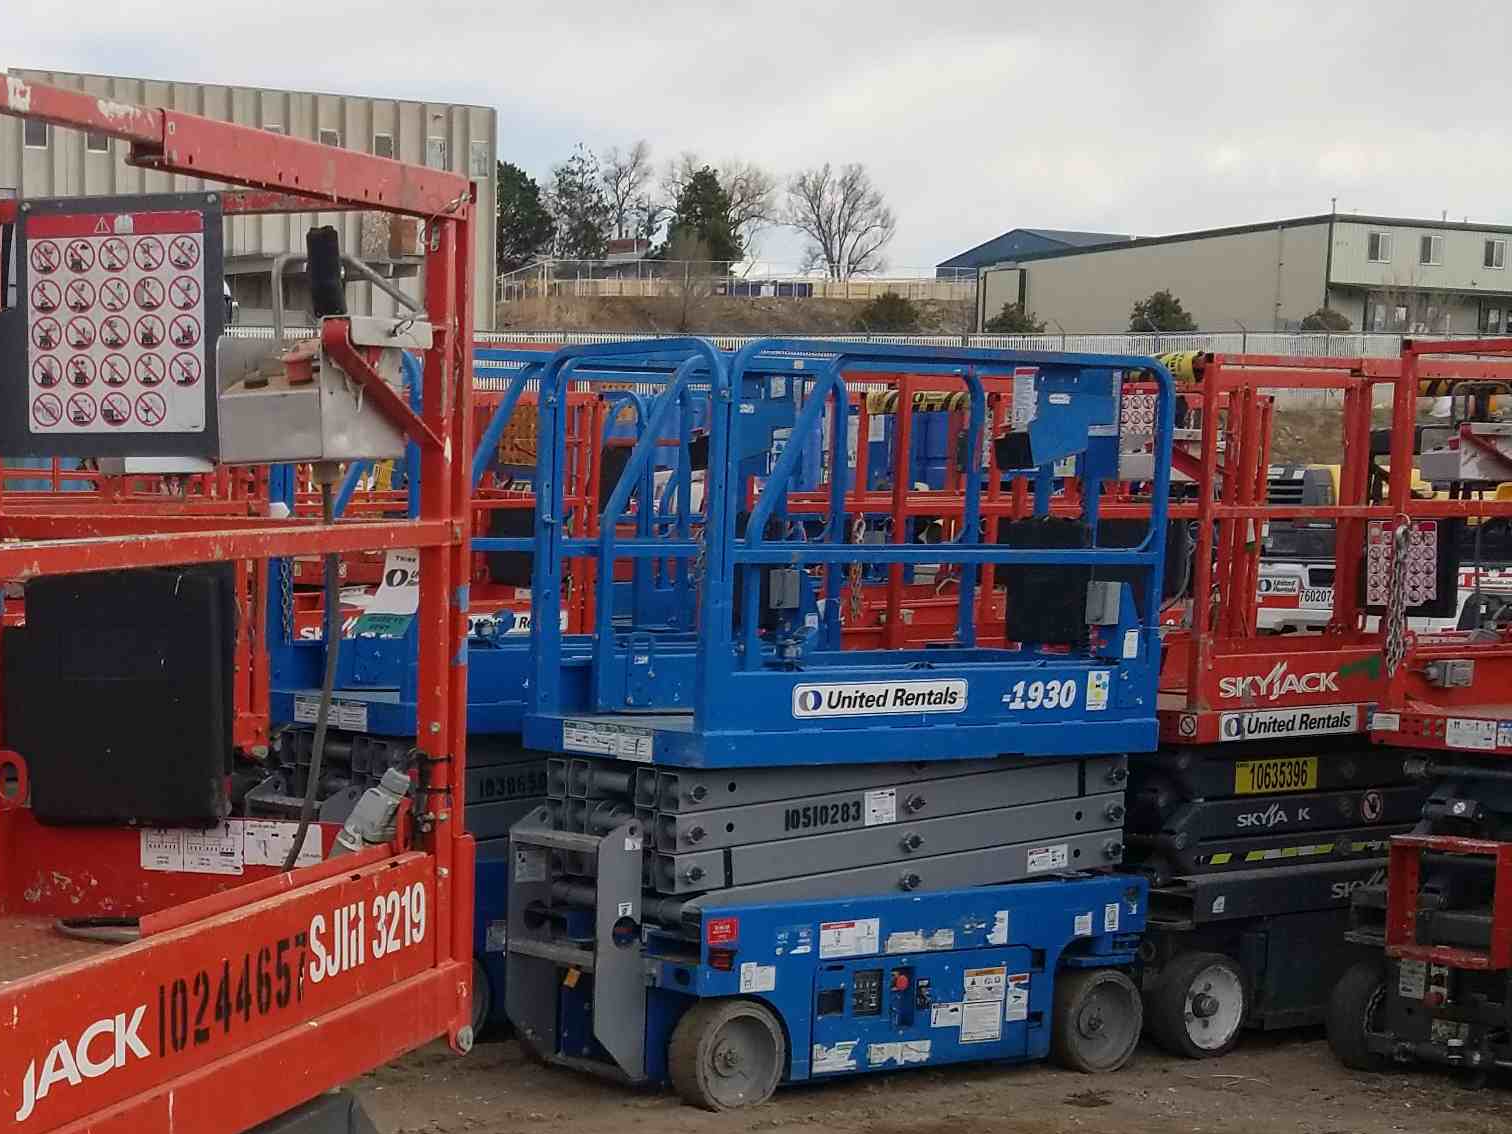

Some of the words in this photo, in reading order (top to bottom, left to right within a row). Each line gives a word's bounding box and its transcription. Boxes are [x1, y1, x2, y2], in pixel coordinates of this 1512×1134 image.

[1219, 661, 1339, 701] SKYJACK
[826, 688, 888, 711] United
[891, 686, 958, 708] Rentals
[1246, 714, 1297, 735] United
[1299, 710, 1351, 731] Rentals
[1249, 759, 1309, 790] 10635396
[784, 801, 862, 832] 10510283
[157, 930, 308, 1059] 10244657
[371, 881, 426, 960] 3219
